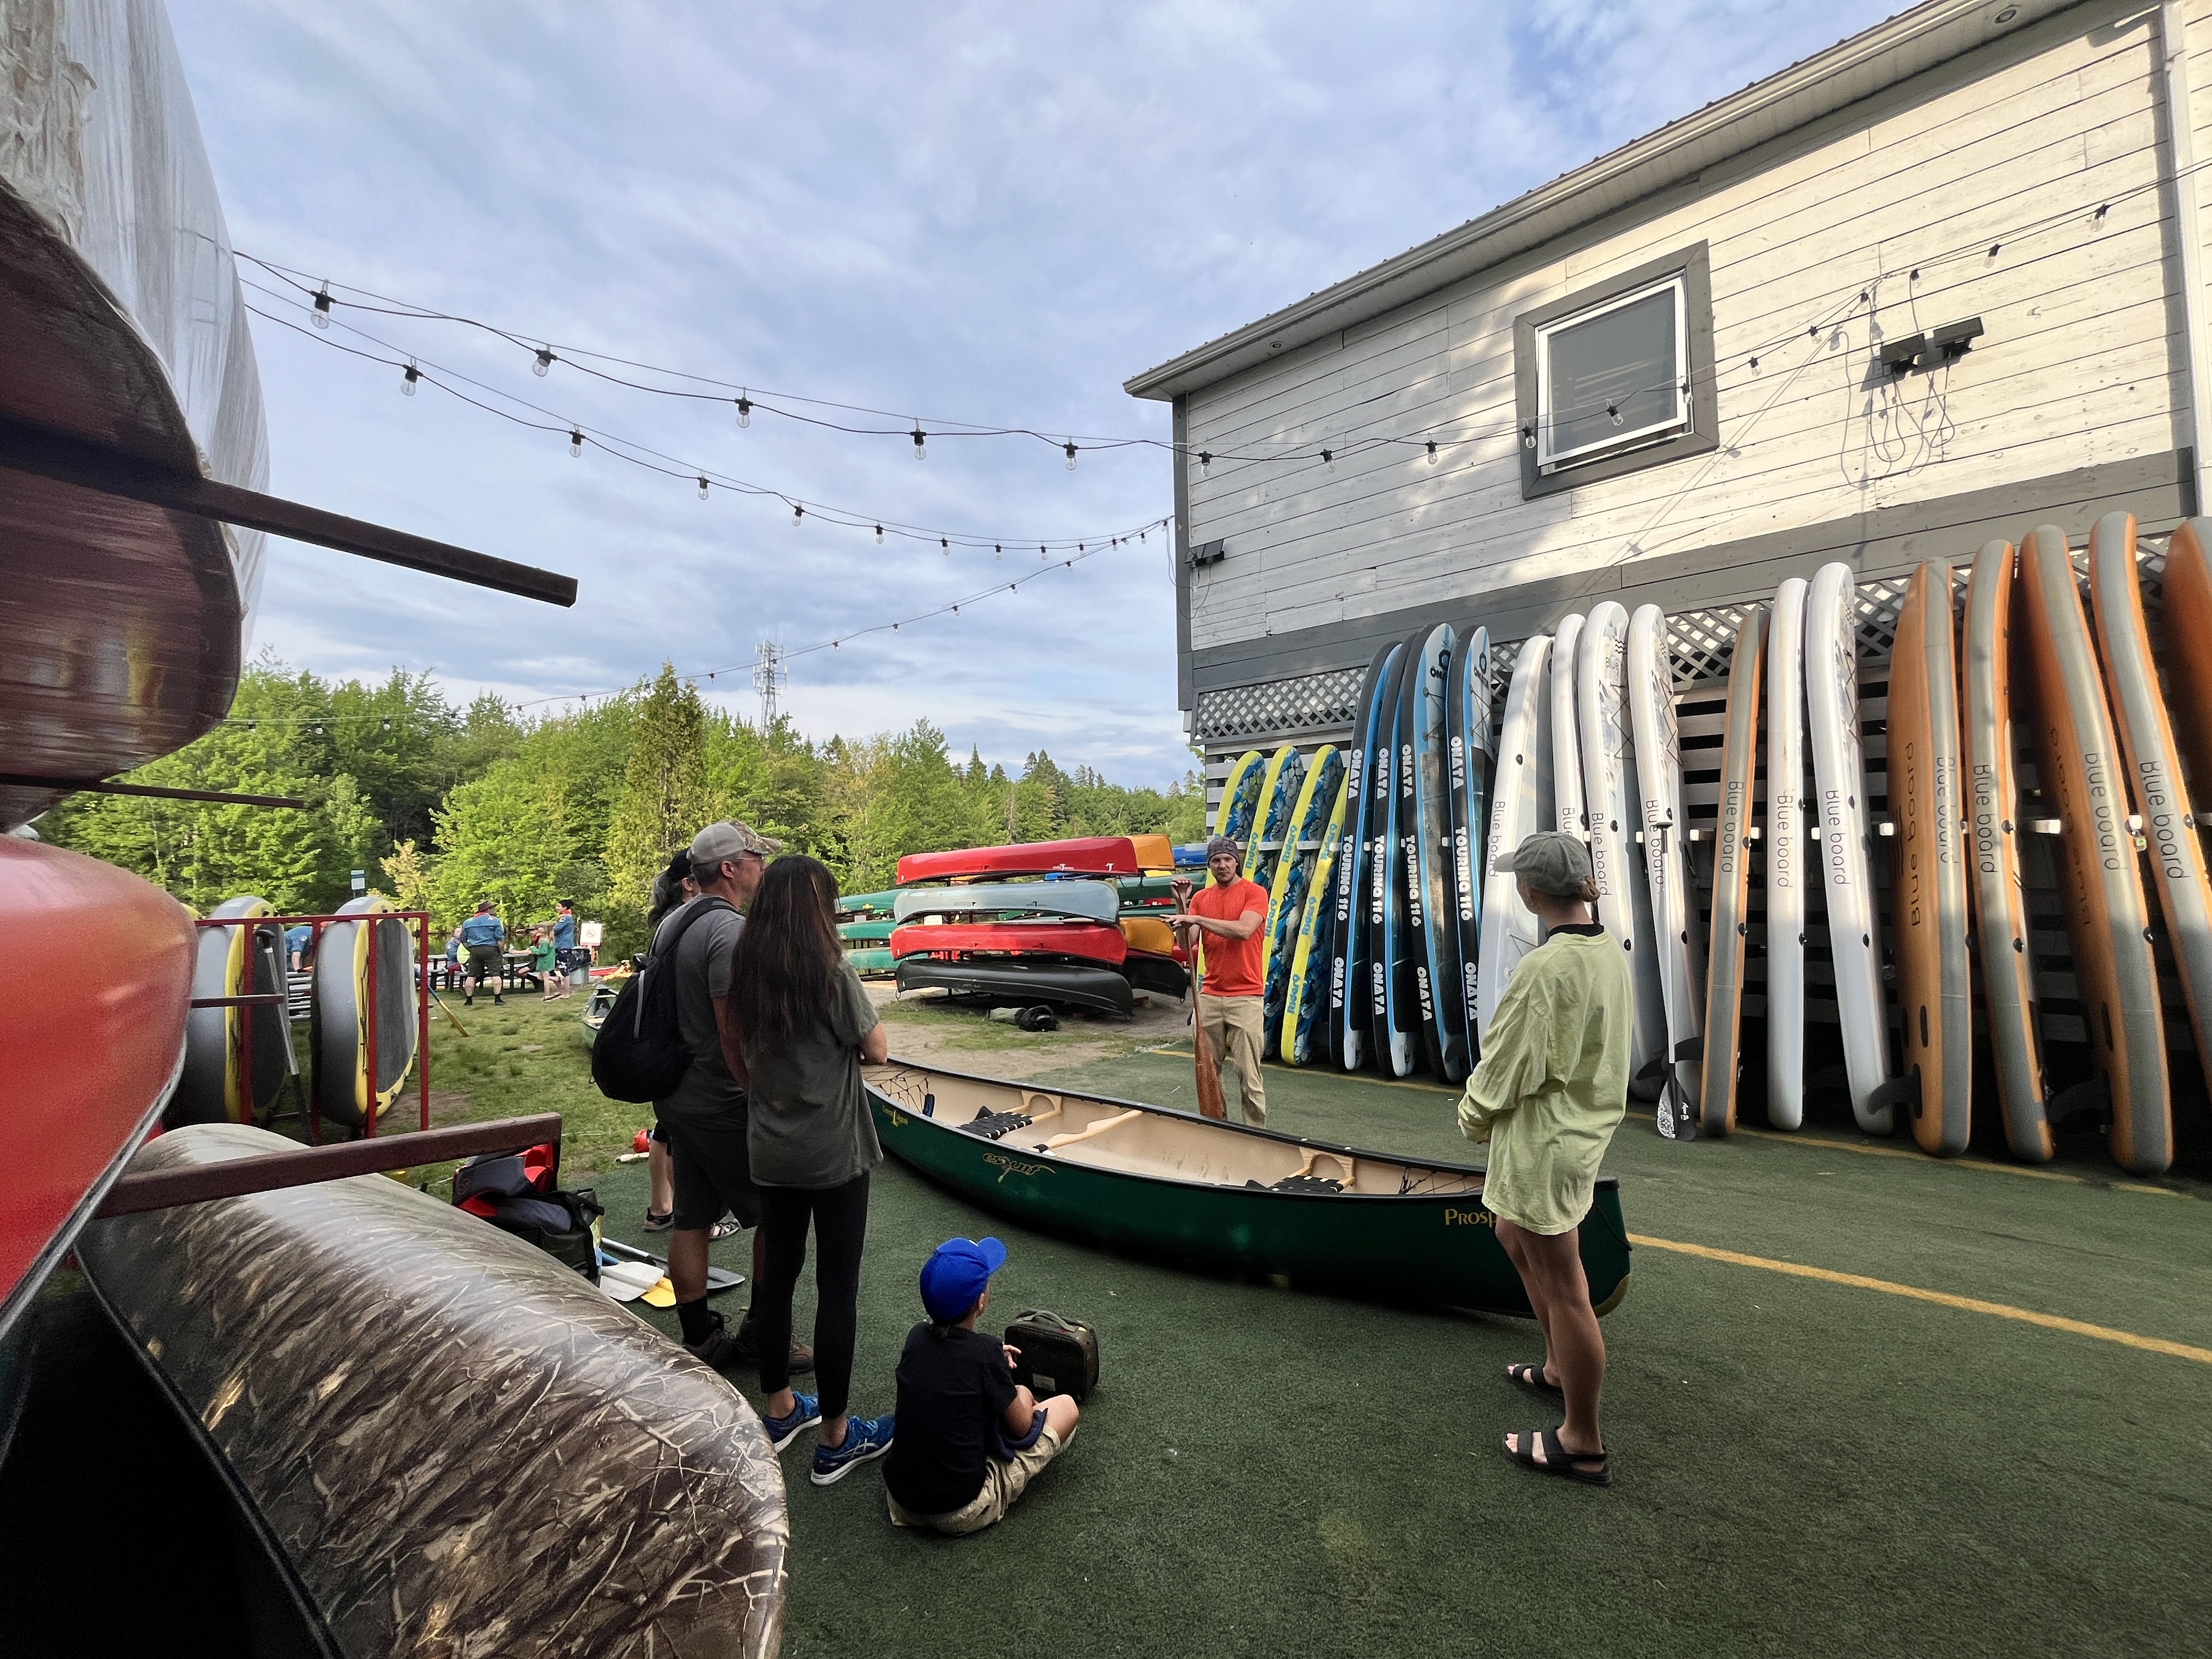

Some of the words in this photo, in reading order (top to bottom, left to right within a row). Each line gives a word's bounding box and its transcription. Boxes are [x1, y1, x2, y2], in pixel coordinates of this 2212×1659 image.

[1348, 749, 1363, 799] ONATA
[1376, 748, 1389, 799] ONATA
[1402, 744, 1414, 798] ONATA
[1450, 736, 1464, 790] ONATA
[1973, 764, 1992, 806] Blue
[1492, 801, 1506, 830] Blue
[1646, 799, 1659, 832] Blue
[1726, 781, 1744, 816] Blue
[1777, 795, 1793, 830] Blue
[1825, 790, 1843, 826] Blue
[2140, 760, 2166, 806] Blue
[2153, 814, 2192, 879] board
[1592, 812, 1604, 845] Blue
[1977, 813, 1998, 873] board
[1339, 834, 1354, 895] TOURING
[1372, 834, 1385, 898] TOURING
[1406, 834, 1419, 900] TOURING
[1455, 826, 1471, 893] TOURING
[1595, 850, 1612, 895] board
[1778, 837, 1793, 888] board
[1830, 833, 1851, 884] board
[1338, 898, 1349, 921] 116
[1372, 900, 1383, 924] 116
[1410, 902, 1422, 927] 116
[1459, 895, 1473, 921] 116
[1911, 853, 1921, 927] Blue
[1332, 957, 1345, 1008] ONATA
[1373, 962, 1385, 1015] ONATA
[1417, 966, 1432, 1021] ONATA
[1465, 962, 1478, 1020] ONATA
